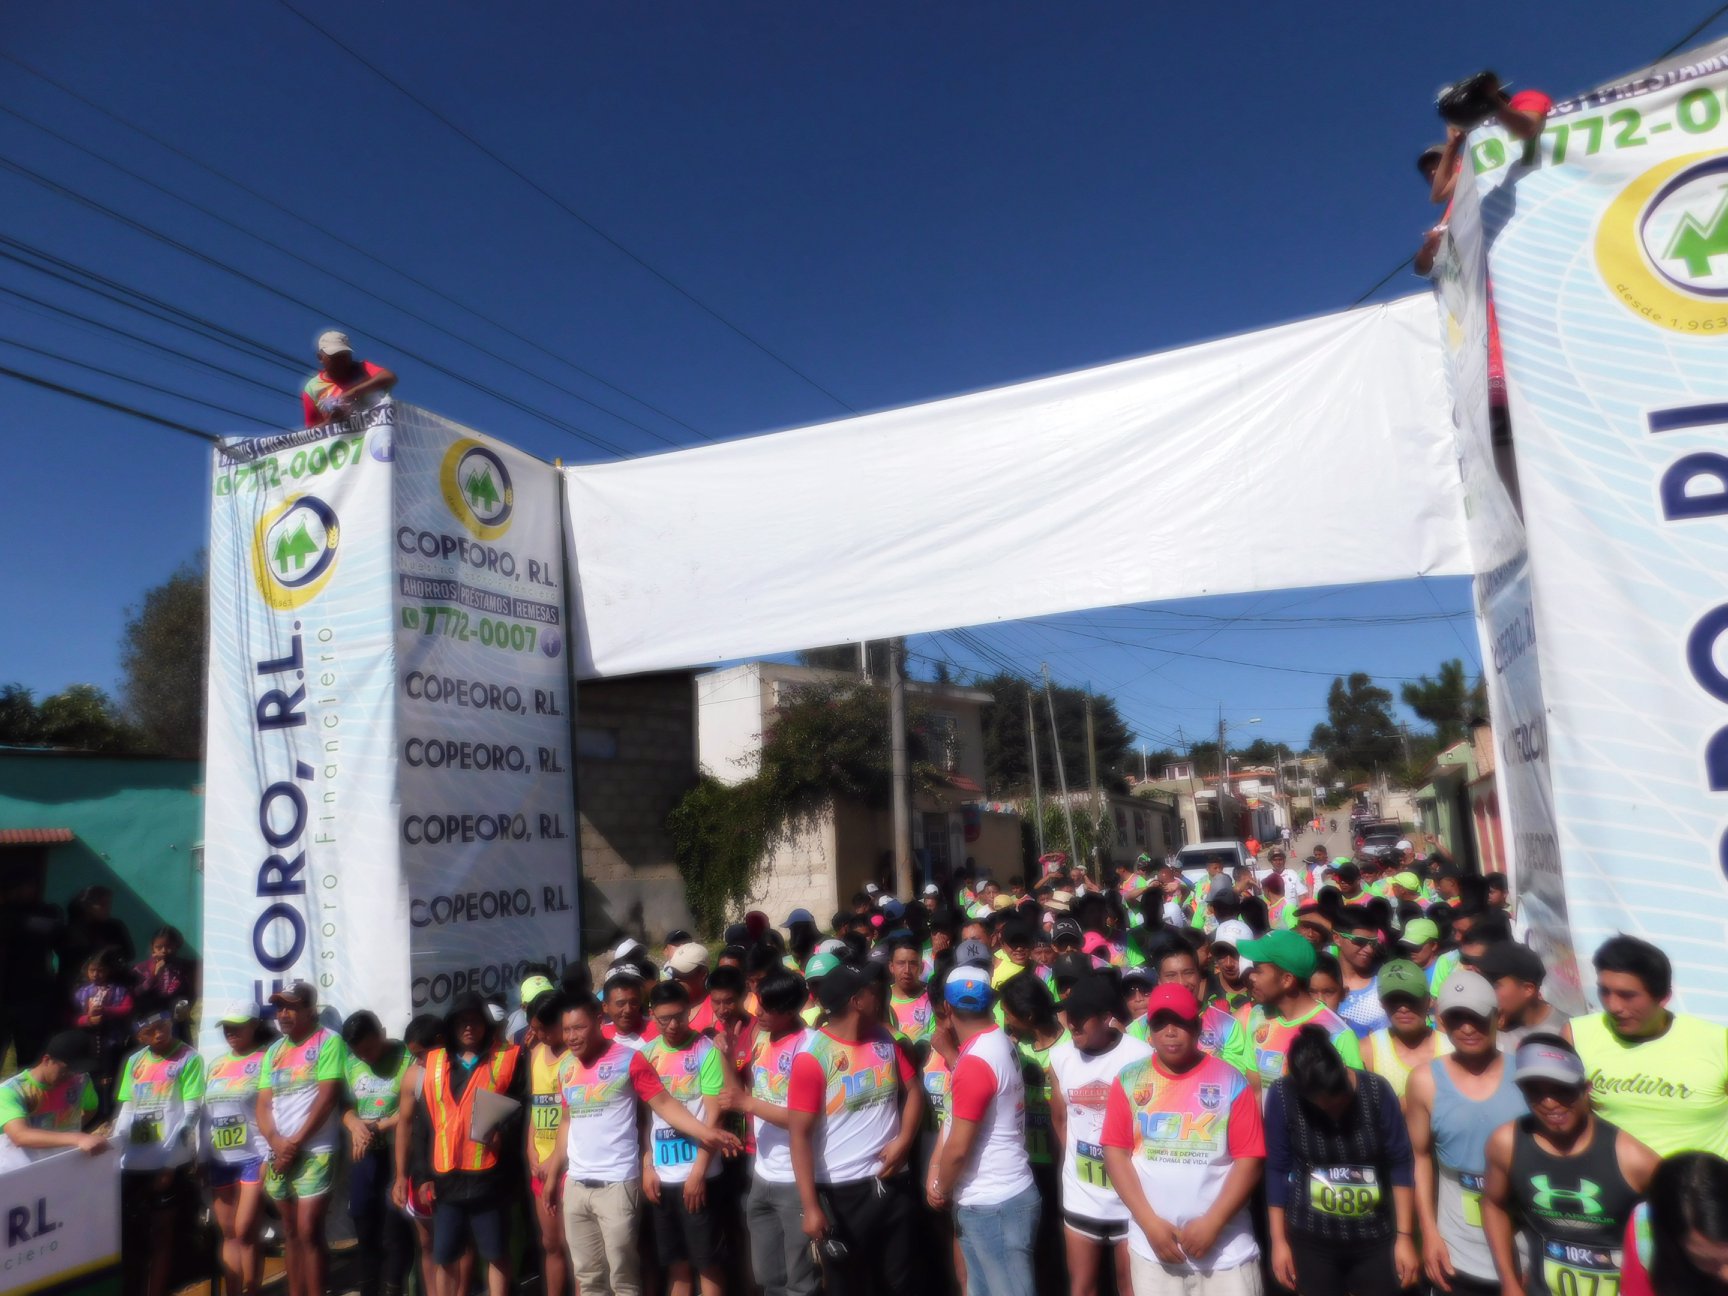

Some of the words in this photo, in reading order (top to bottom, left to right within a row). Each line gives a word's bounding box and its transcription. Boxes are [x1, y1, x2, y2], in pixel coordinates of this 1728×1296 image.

[1510, 83, 1728, 168] 7772-0
[396, 526, 521, 582] COPEORO,
[528, 558, 559, 589] R.L.
[403, 578, 458, 600] AHORROS
[460, 584, 510, 615] PRÉSTAMOS
[516, 606, 558, 624] REMESAS
[420, 606, 537, 653] 7772-0007
[256, 619, 306, 732] R.L.
[405, 670, 527, 716] COPEORO,
[534, 689, 564, 717] R.L.
[314, 626, 339, 844] Financiero
[404, 737, 531, 775] COPEORO,
[538, 747, 566, 773] R.L.
[403, 814, 533, 845] COPEORO,
[539, 813, 569, 840] R.L.
[410, 888, 537, 928] COPEORO,
[543, 885, 573, 912] R.L.
[842, 1062, 897, 1099] 10K
[536, 1107, 559, 1128] 112
[1136, 1110, 1217, 1142] 10K
[217, 1128, 243, 1148] 102
[660, 1141, 693, 1165] 010
[1084, 1161, 1107, 1187] 11
[1329, 1167, 1350, 1180] 10K
[1319, 1186, 1374, 1214] 089
[1564, 1212, 1616, 1224] ARMOUR
[7, 1197, 63, 1249] R.L.
[1565, 1245, 1592, 1265] 10K
